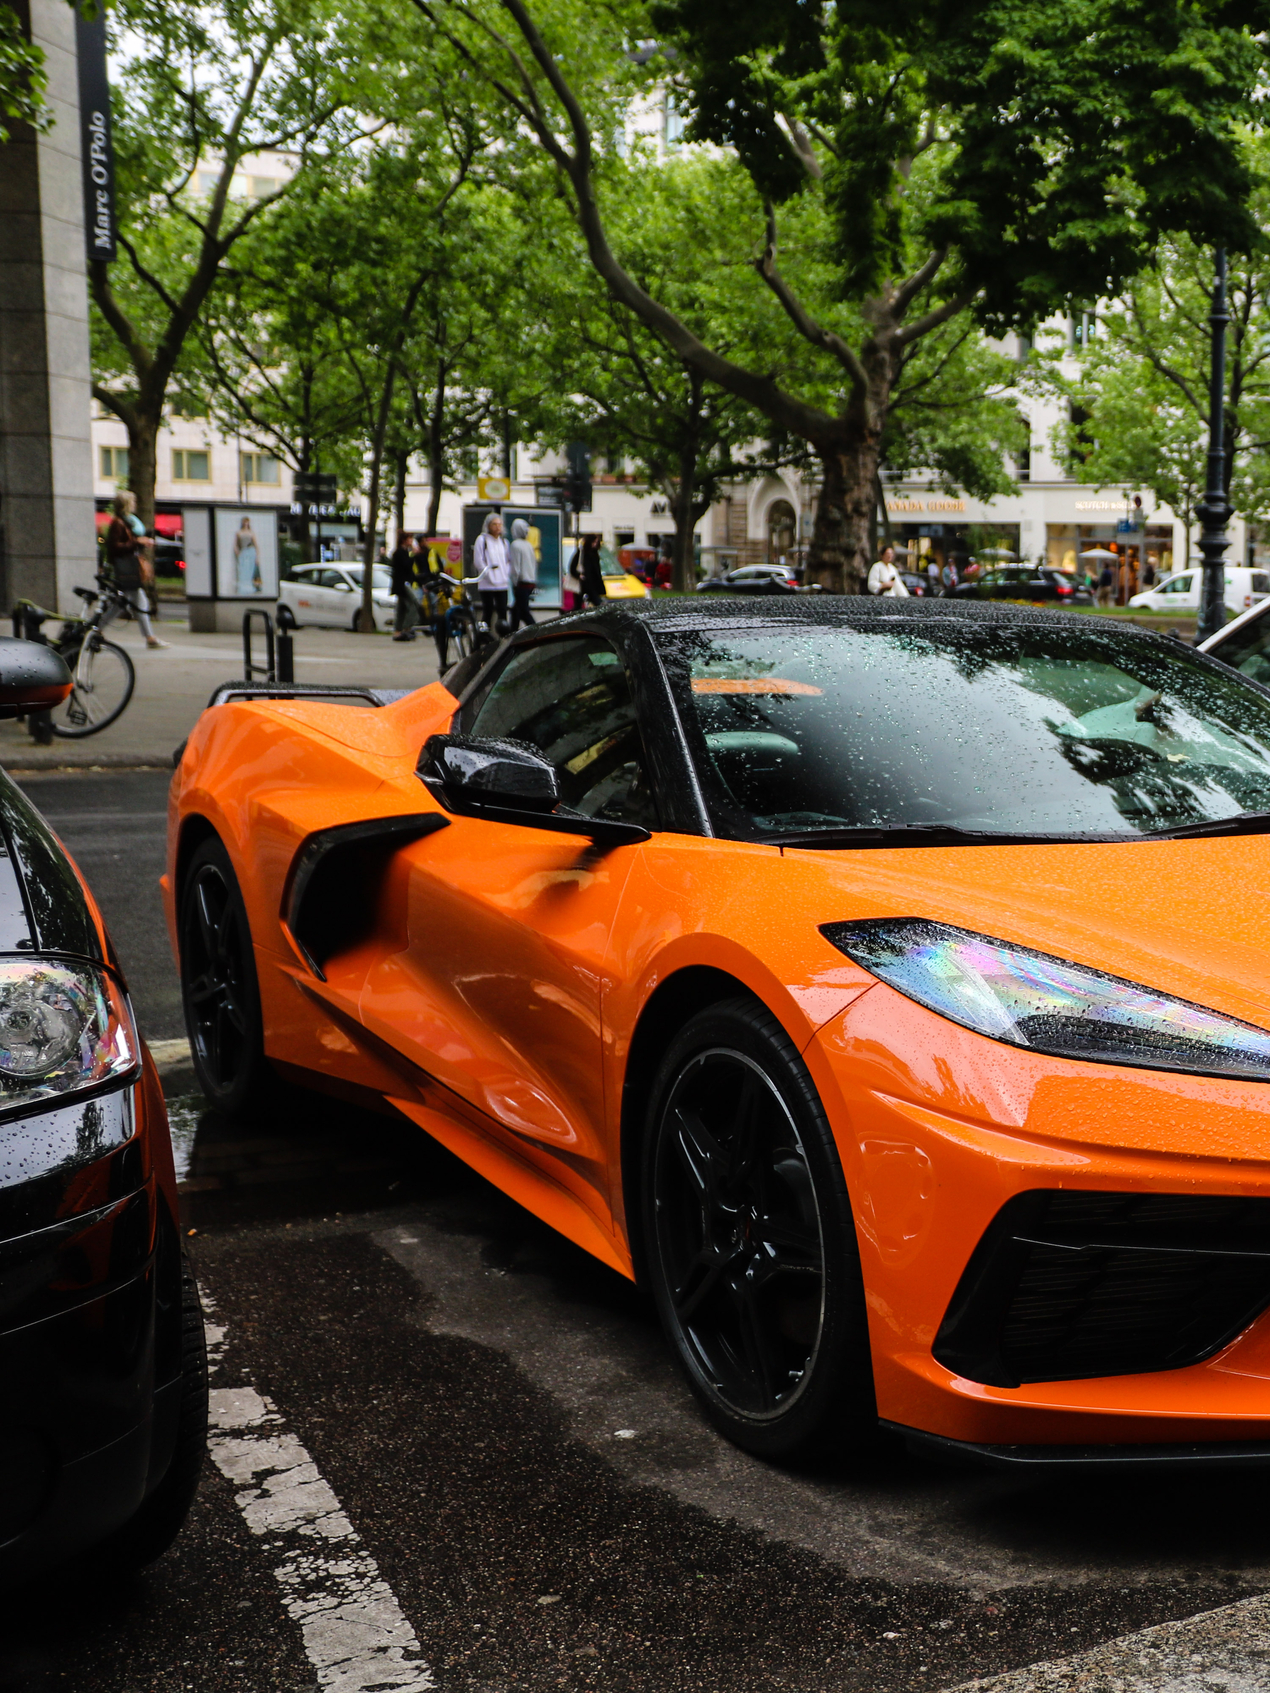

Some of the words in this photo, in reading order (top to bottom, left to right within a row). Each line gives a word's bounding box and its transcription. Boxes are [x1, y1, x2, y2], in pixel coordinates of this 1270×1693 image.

[89, 111, 109, 185] O'Polo
[94, 189, 112, 250] Marc
[885, 500, 925, 513] ANADA
